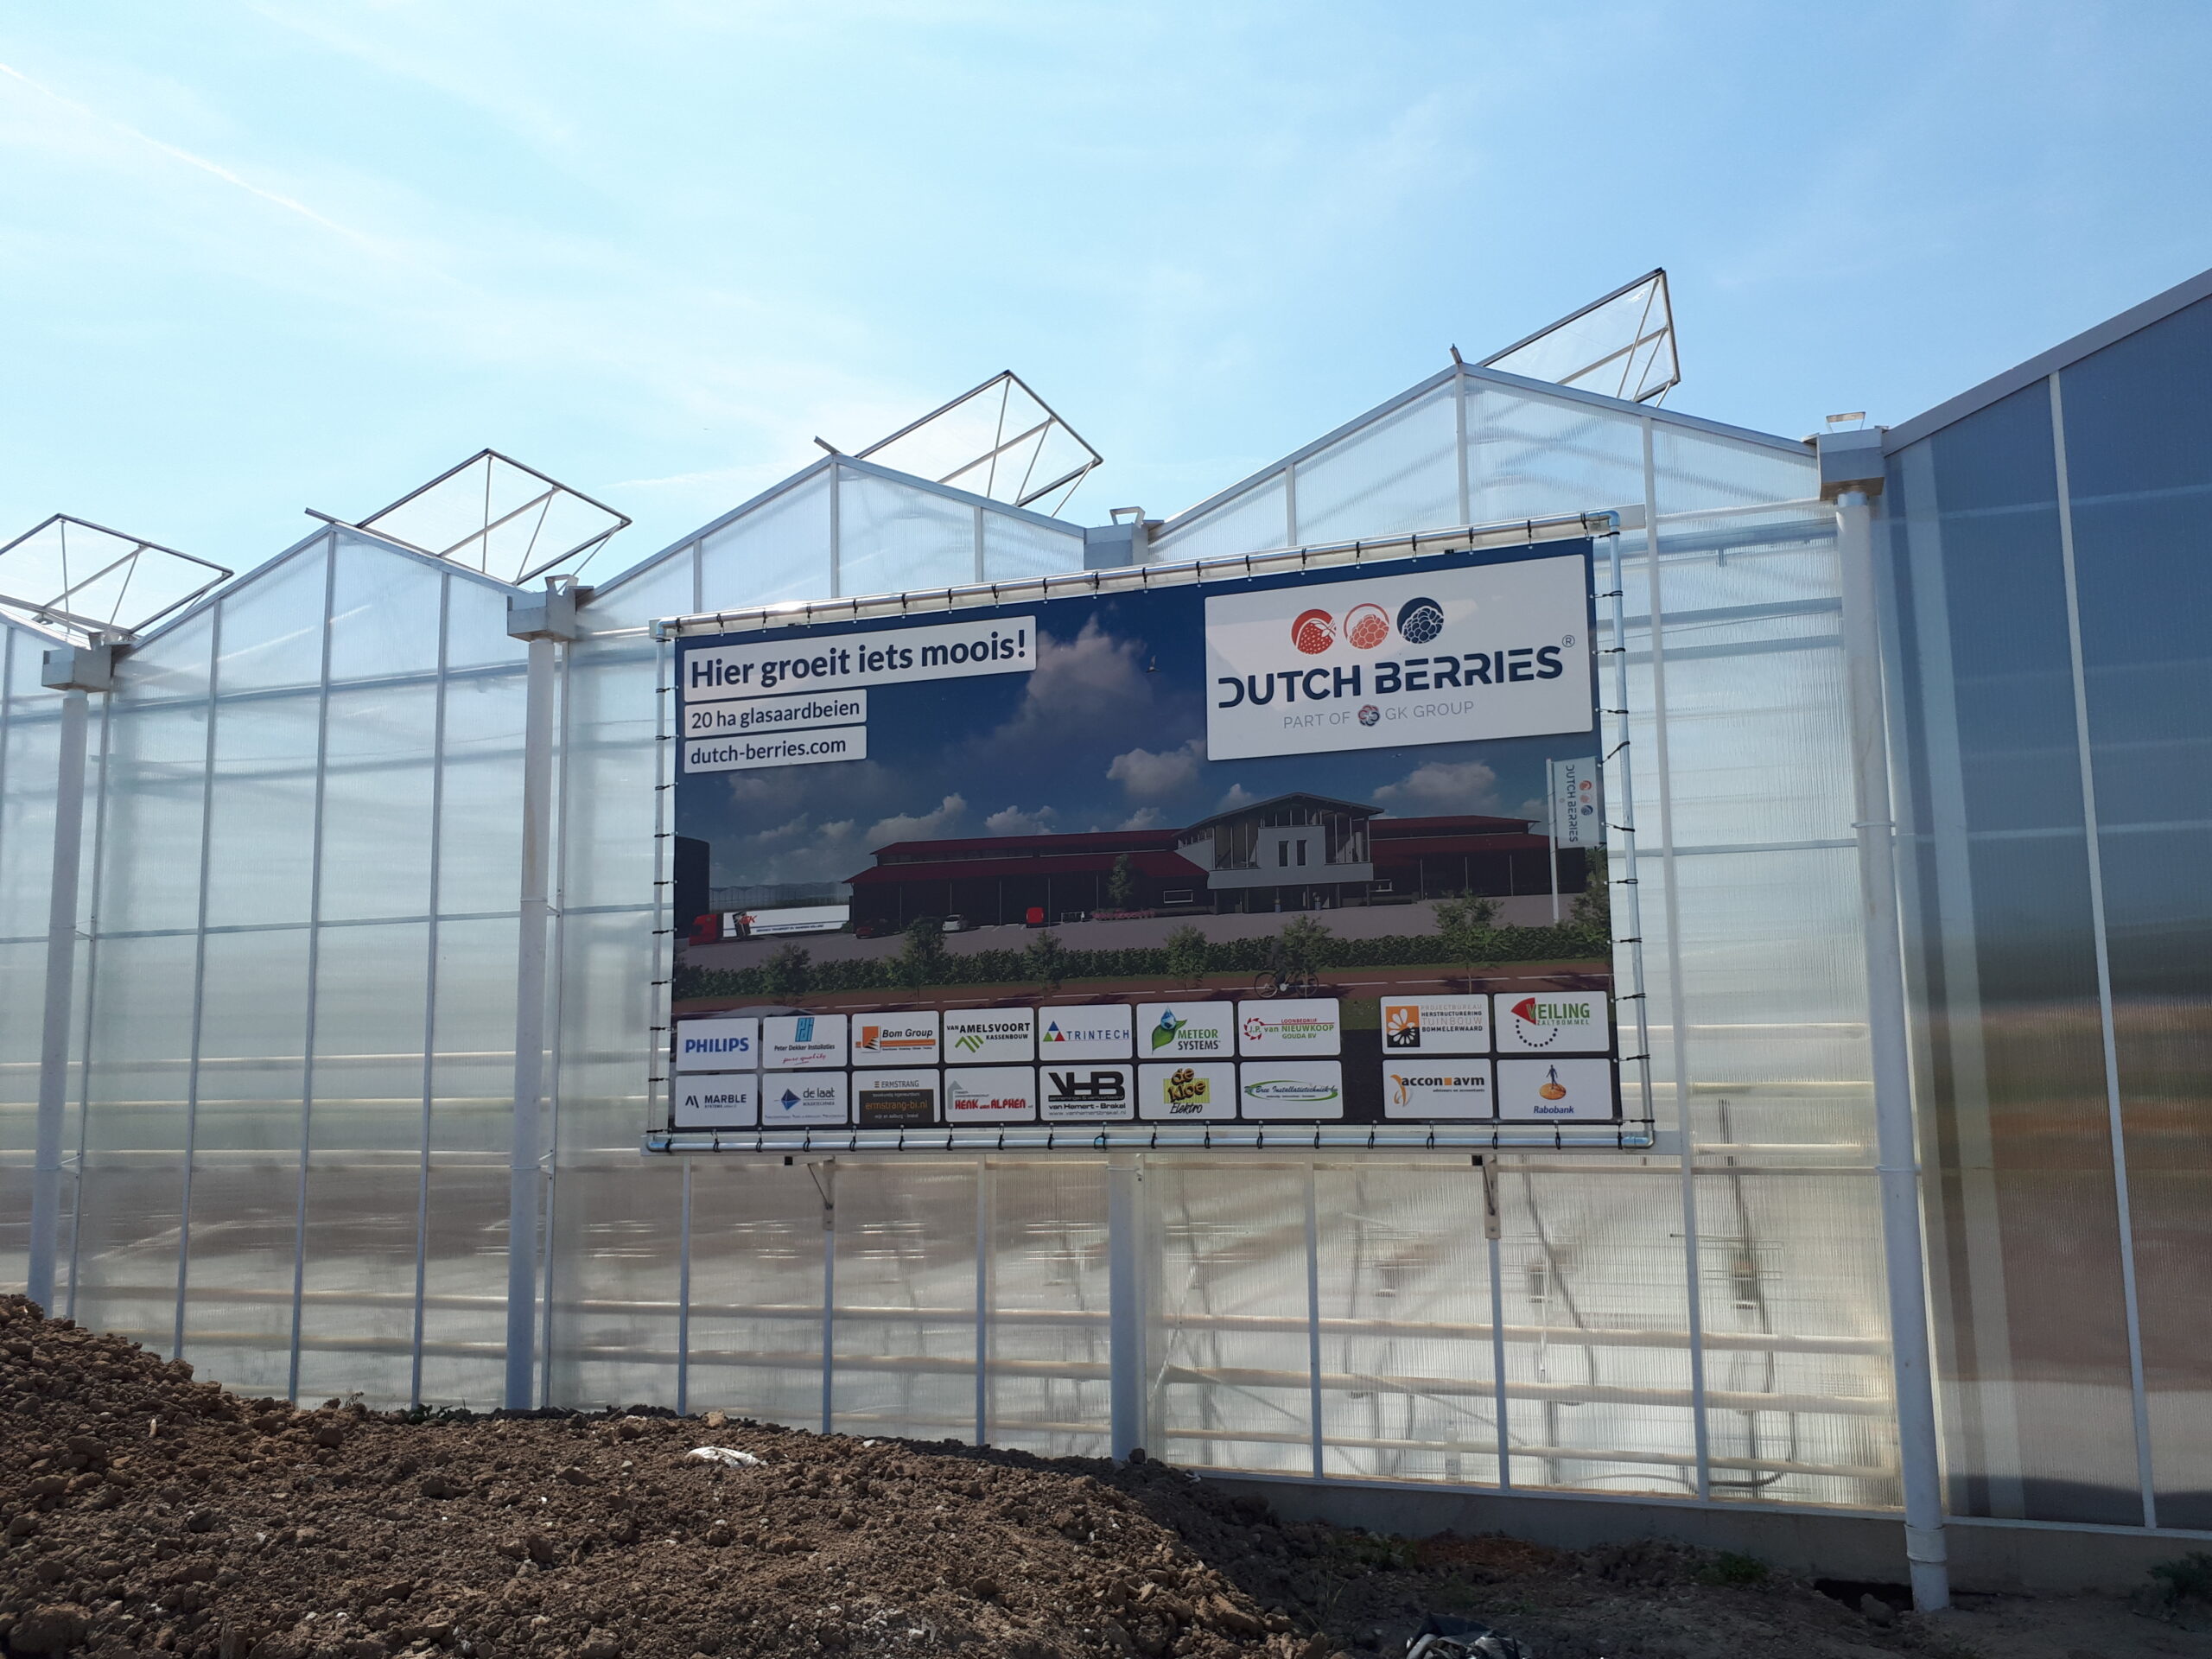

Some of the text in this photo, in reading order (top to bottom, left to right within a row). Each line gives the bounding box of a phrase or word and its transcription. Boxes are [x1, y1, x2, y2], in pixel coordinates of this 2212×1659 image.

[691, 629, 1027, 689] Hier groeit iets moois!
[1218, 664, 1361, 709] DUTCH
[1375, 645, 1563, 695] BERRIES
[691, 700, 860, 729] 20 ha glasaardbeien
[1284, 701, 1474, 729] PART OF GK GROUP
[691, 738, 847, 765] dutch-berries.com
[1566, 764, 1579, 842] DUTCH BERRIES
[1526, 1002, 1591, 1020] VEILING
[959, 1022, 1031, 1033] AMELSVOORT
[1421, 1017, 1483, 1026] TUINBOUW
[882, 1028, 933, 1039] Bom Group
[1066, 1029, 1129, 1040] TRINTECH
[1177, 1029, 1218, 1039] METEOR
[1281, 1024, 1335, 1033] NIEUWKOOP
[685, 1037, 749, 1053] PHILIPS
[1178, 1040, 1218, 1051] SYSTEMS
[1172, 1068, 1194, 1085] de
[1401, 1077, 1485, 1086] accon avm
[802, 1086, 836, 1098] de laat
[1167, 1081, 1206, 1103] kloe
[704, 1094, 747, 1103] MARBLE
[954, 1099, 979, 1109] HENK
[990, 1097, 1027, 1109] ALPHEN
[1169, 1103, 1204, 1114] Elektro
[1533, 1105, 1574, 1114] Rabobank
